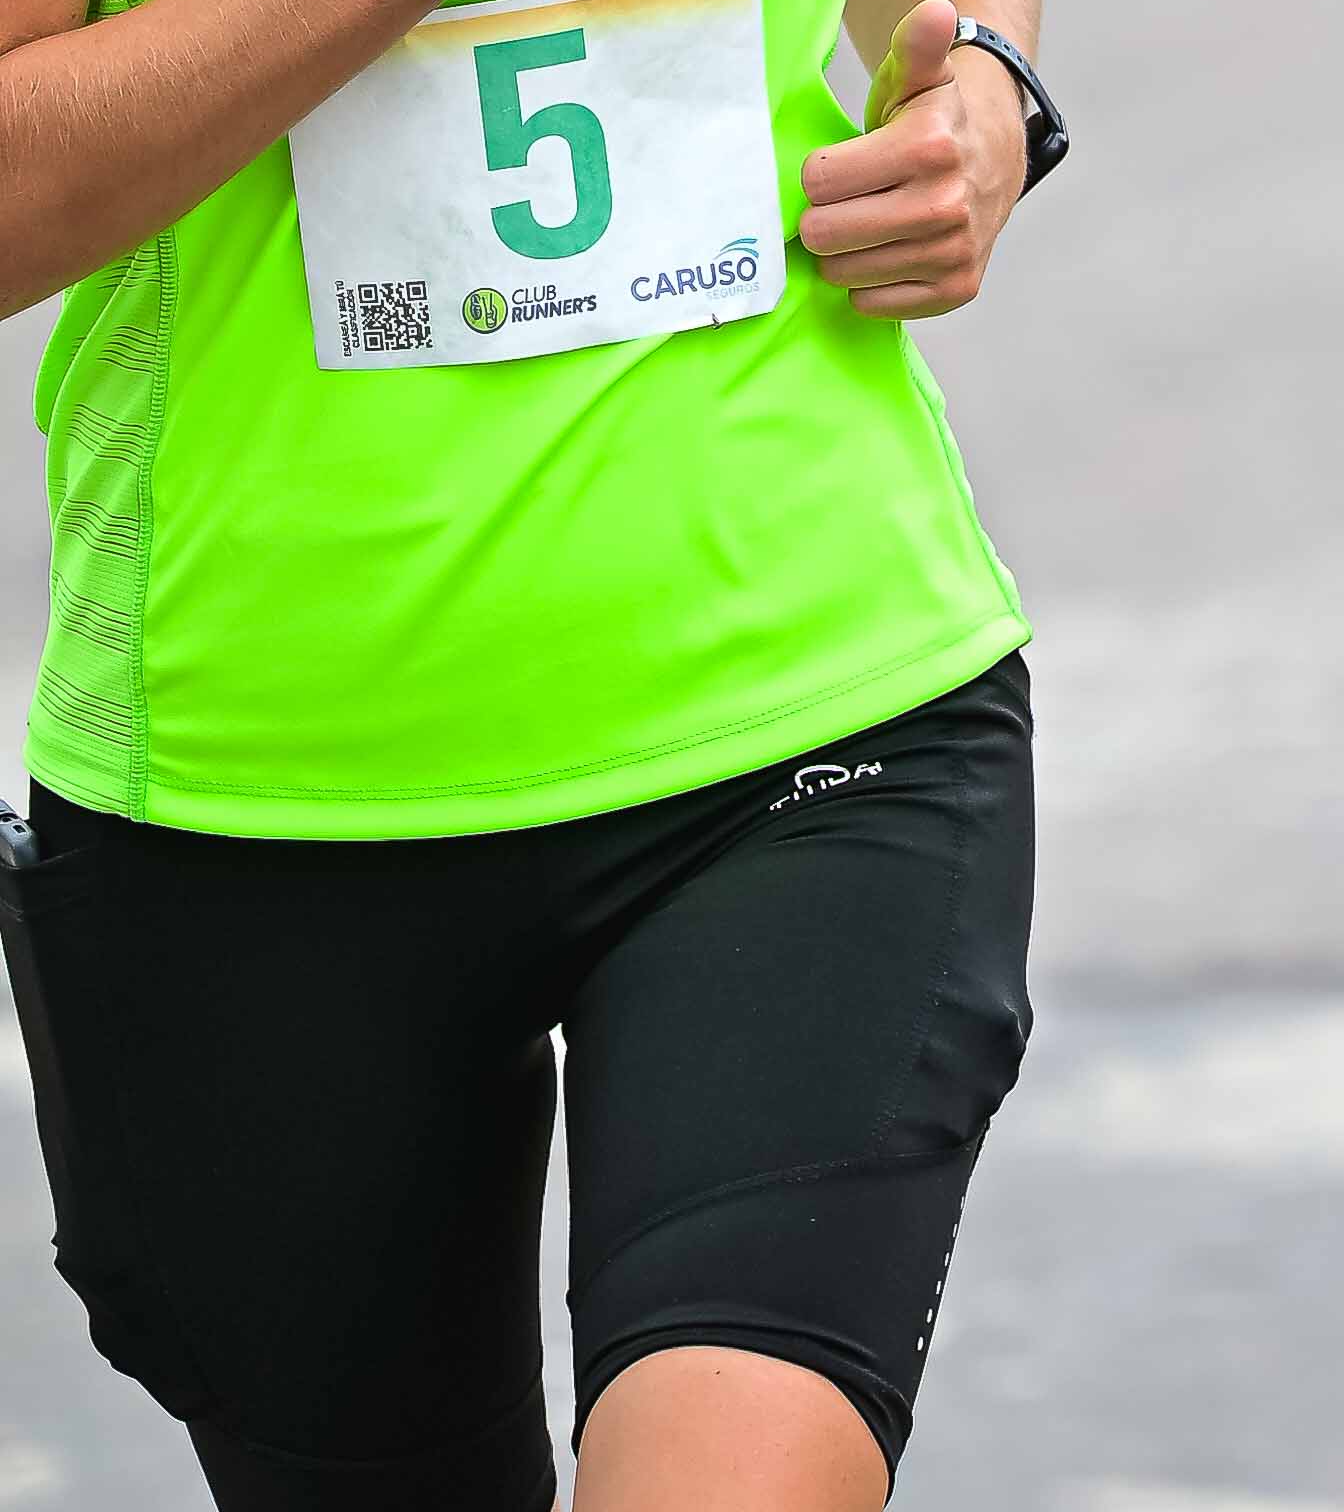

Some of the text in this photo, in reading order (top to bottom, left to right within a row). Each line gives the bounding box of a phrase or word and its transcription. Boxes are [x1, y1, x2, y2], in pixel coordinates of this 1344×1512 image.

[473, 27, 613, 260] 5
[511, 285, 557, 305] CLUB
[631, 257, 758, 301] CARUSO
[511, 295, 597, 323] RUNNER'S
